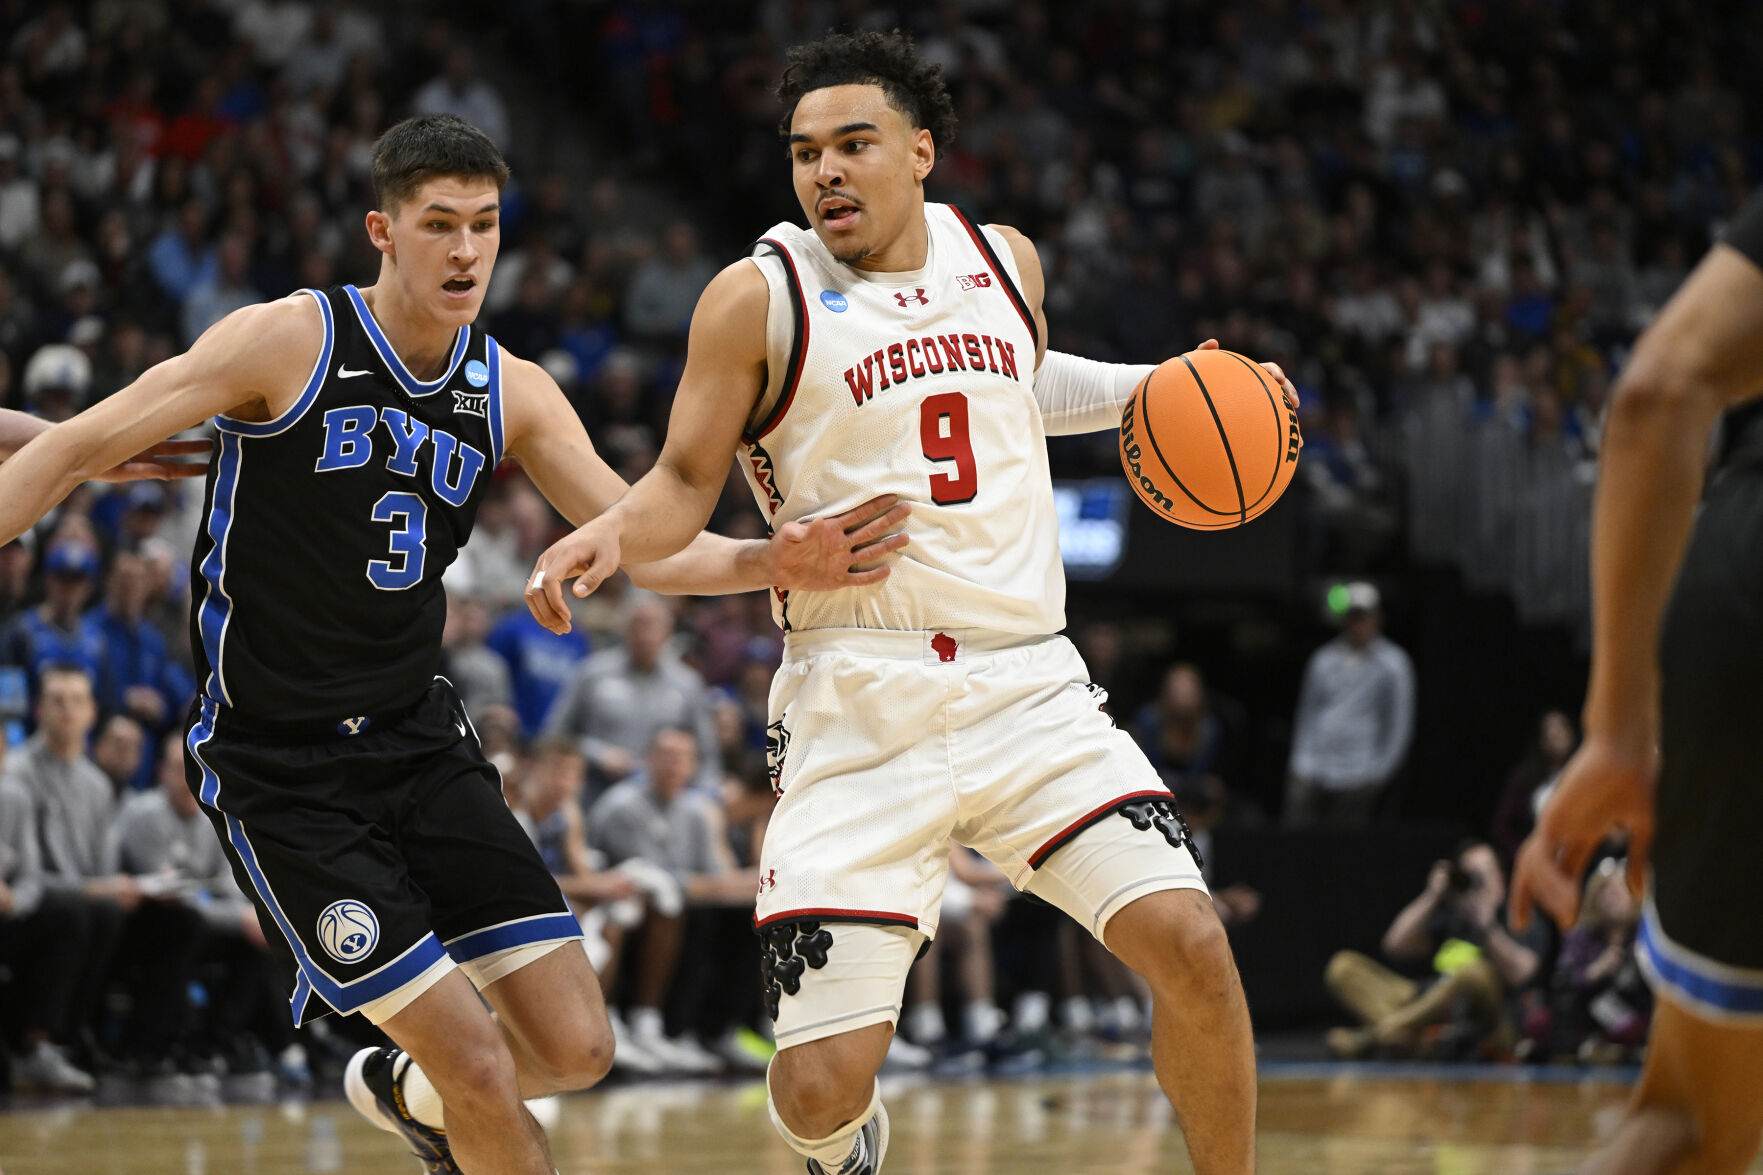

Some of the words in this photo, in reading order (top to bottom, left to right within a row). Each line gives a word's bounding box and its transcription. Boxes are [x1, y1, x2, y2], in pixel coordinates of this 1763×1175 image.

[451, 390, 489, 418] XII
[467, 371, 488, 382] NCAA
[844, 333, 1019, 407] WISCONSIN
[315, 405, 486, 507] BYU
[920, 391, 978, 506] 9
[1122, 394, 1174, 512] Wilson
[366, 491, 428, 590] 3
[343, 716, 365, 735] Y
[343, 935, 361, 951] Y
